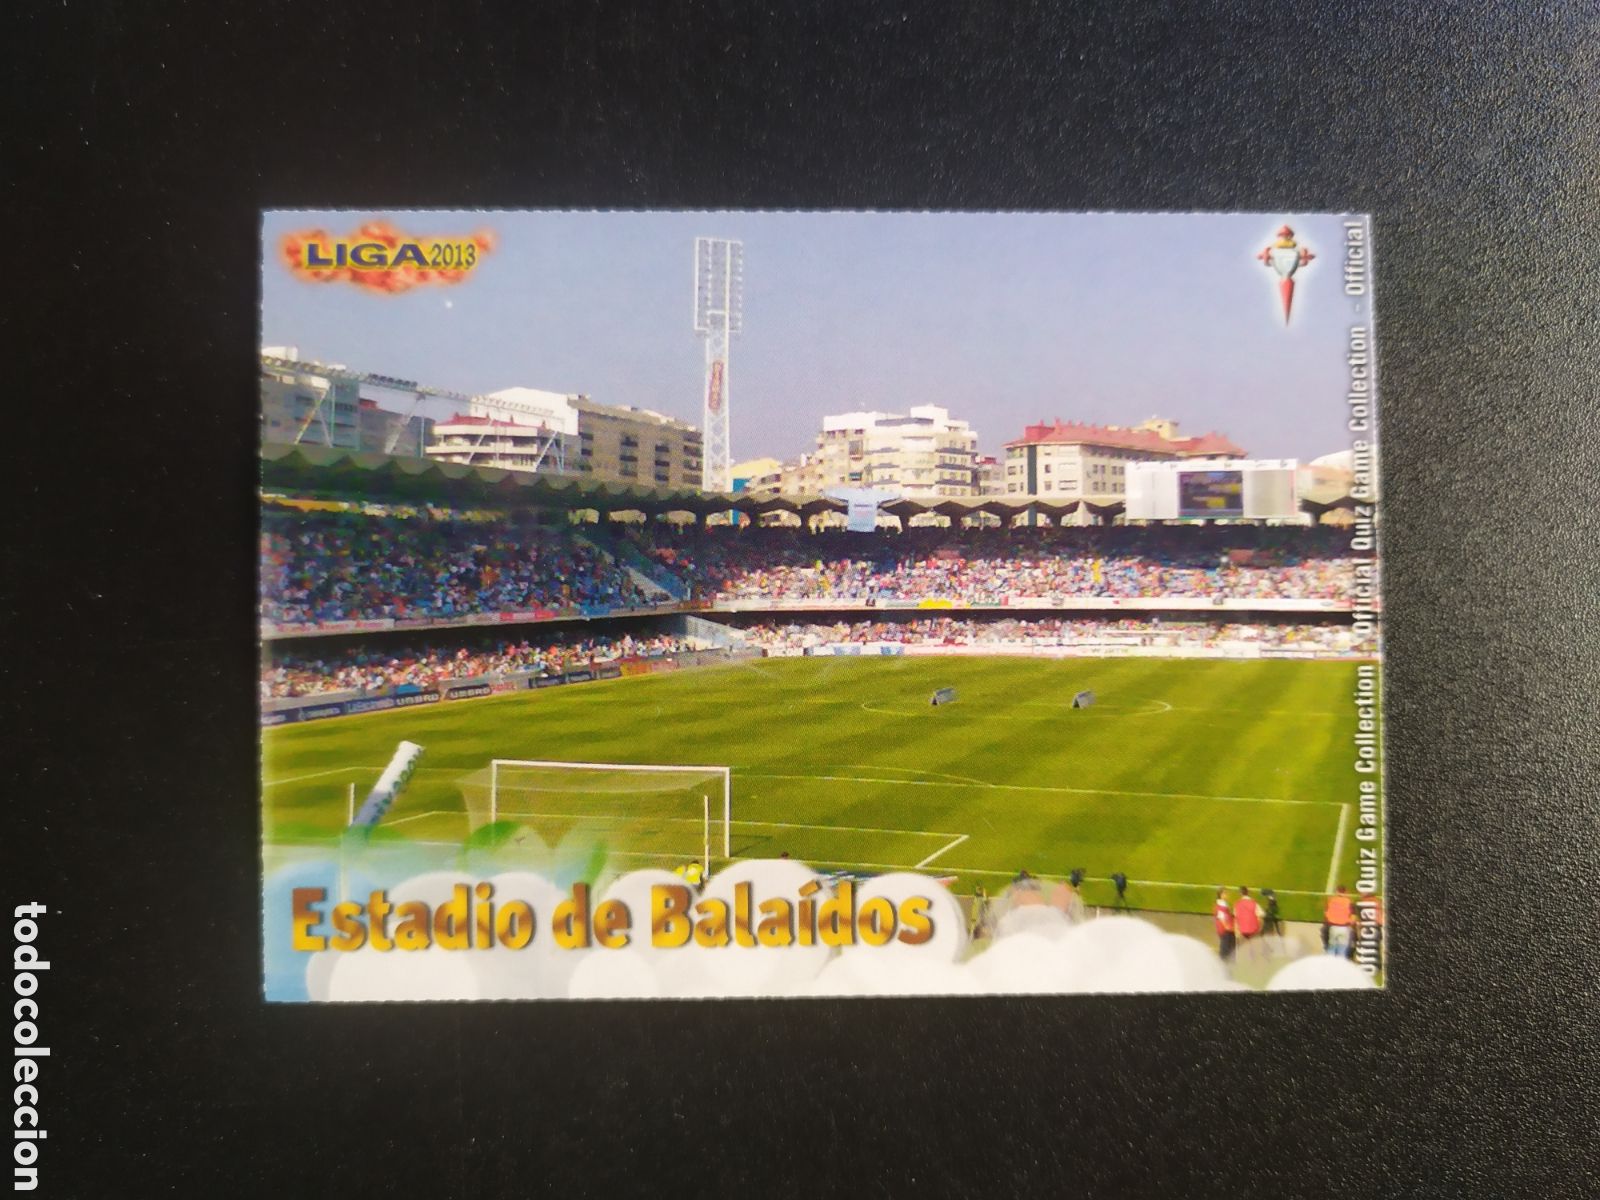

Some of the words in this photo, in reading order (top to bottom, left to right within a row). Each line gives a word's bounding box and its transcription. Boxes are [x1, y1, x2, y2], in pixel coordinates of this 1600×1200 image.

[307, 243, 430, 268] LIGA
[430, 243, 476, 268] 2013
[1344, 221, 1366, 296] Official
[1347, 326, 1368, 432] Collection
[1350, 439, 1371, 499] Game
[1350, 505, 1374, 551] Quiz
[1351, 558, 1375, 636] Official
[1353, 664, 1377, 774] Collection
[1355, 780, 1377, 842] Game
[1355, 847, 1377, 894] Quiz
[292, 881, 537, 951] Estadio
[552, 882, 632, 950] de
[651, 880, 936, 949] Balaídos
[1354, 900, 1378, 976] Official
